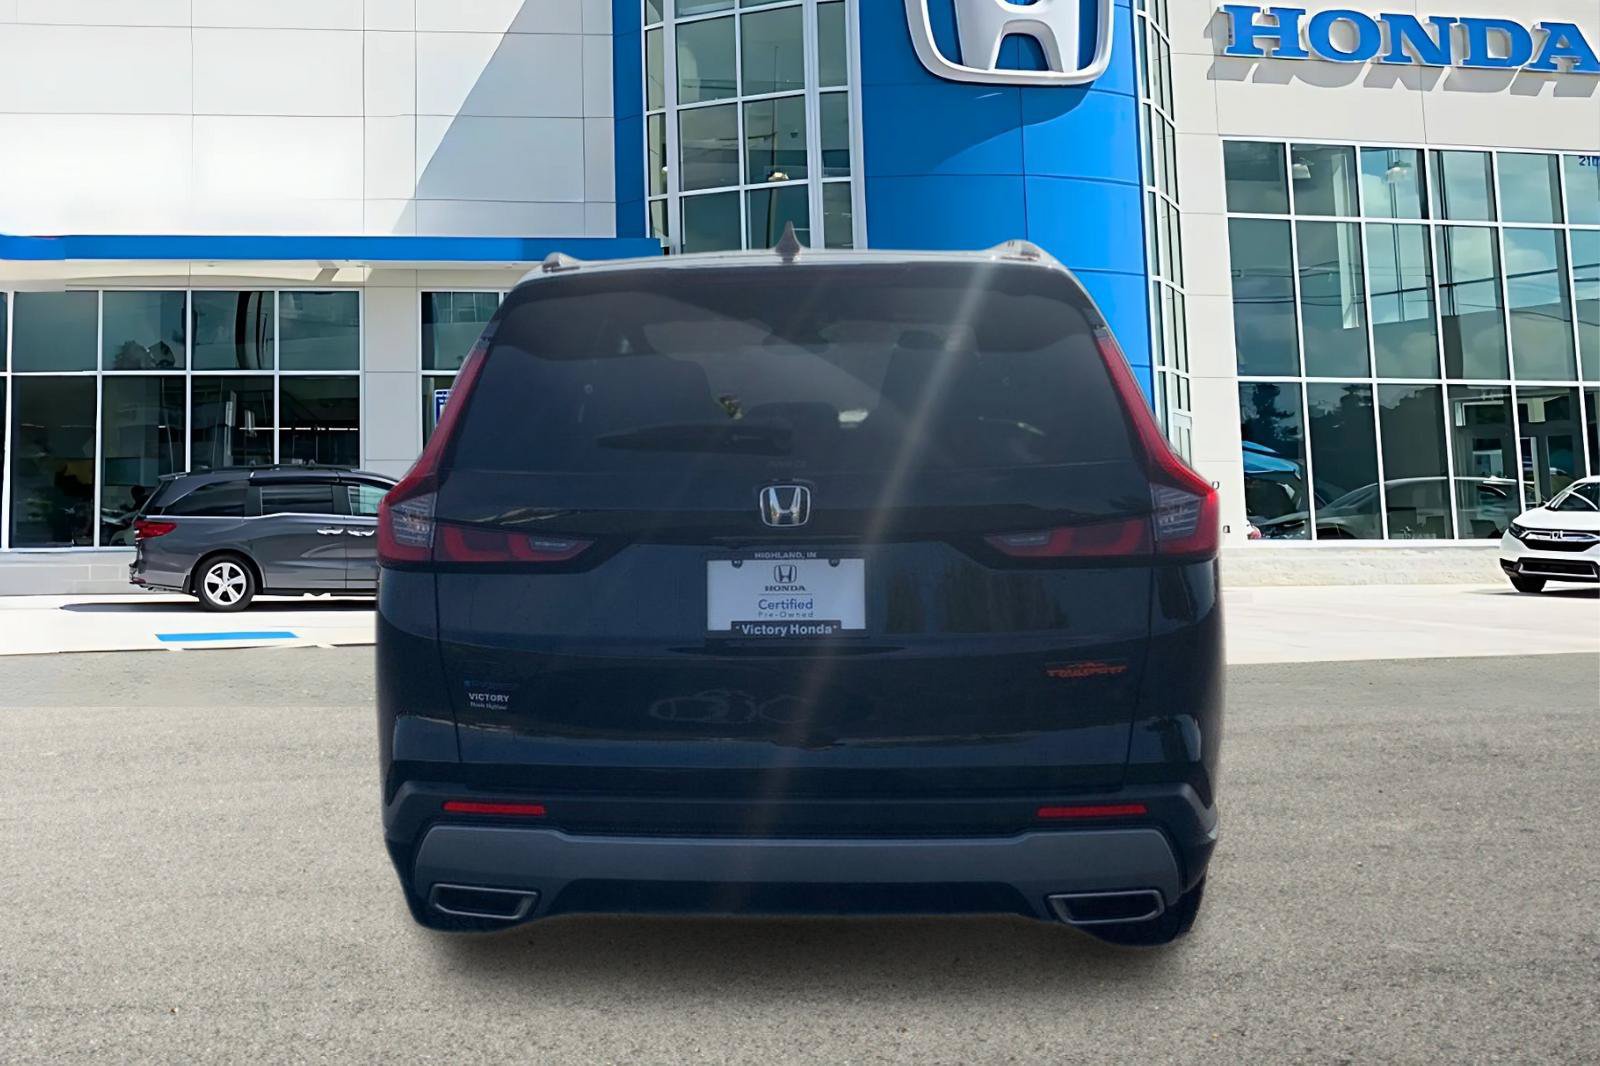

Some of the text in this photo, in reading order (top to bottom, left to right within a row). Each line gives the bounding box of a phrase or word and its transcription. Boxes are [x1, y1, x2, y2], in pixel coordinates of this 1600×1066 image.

[1220, 4, 1600, 74] HONDA
[754, 551, 817, 560] HIGHLAND, IN
[758, 598, 814, 610] Certified
[741, 623, 833, 637] Victory Honda
[468, 692, 510, 702] VICTORY
